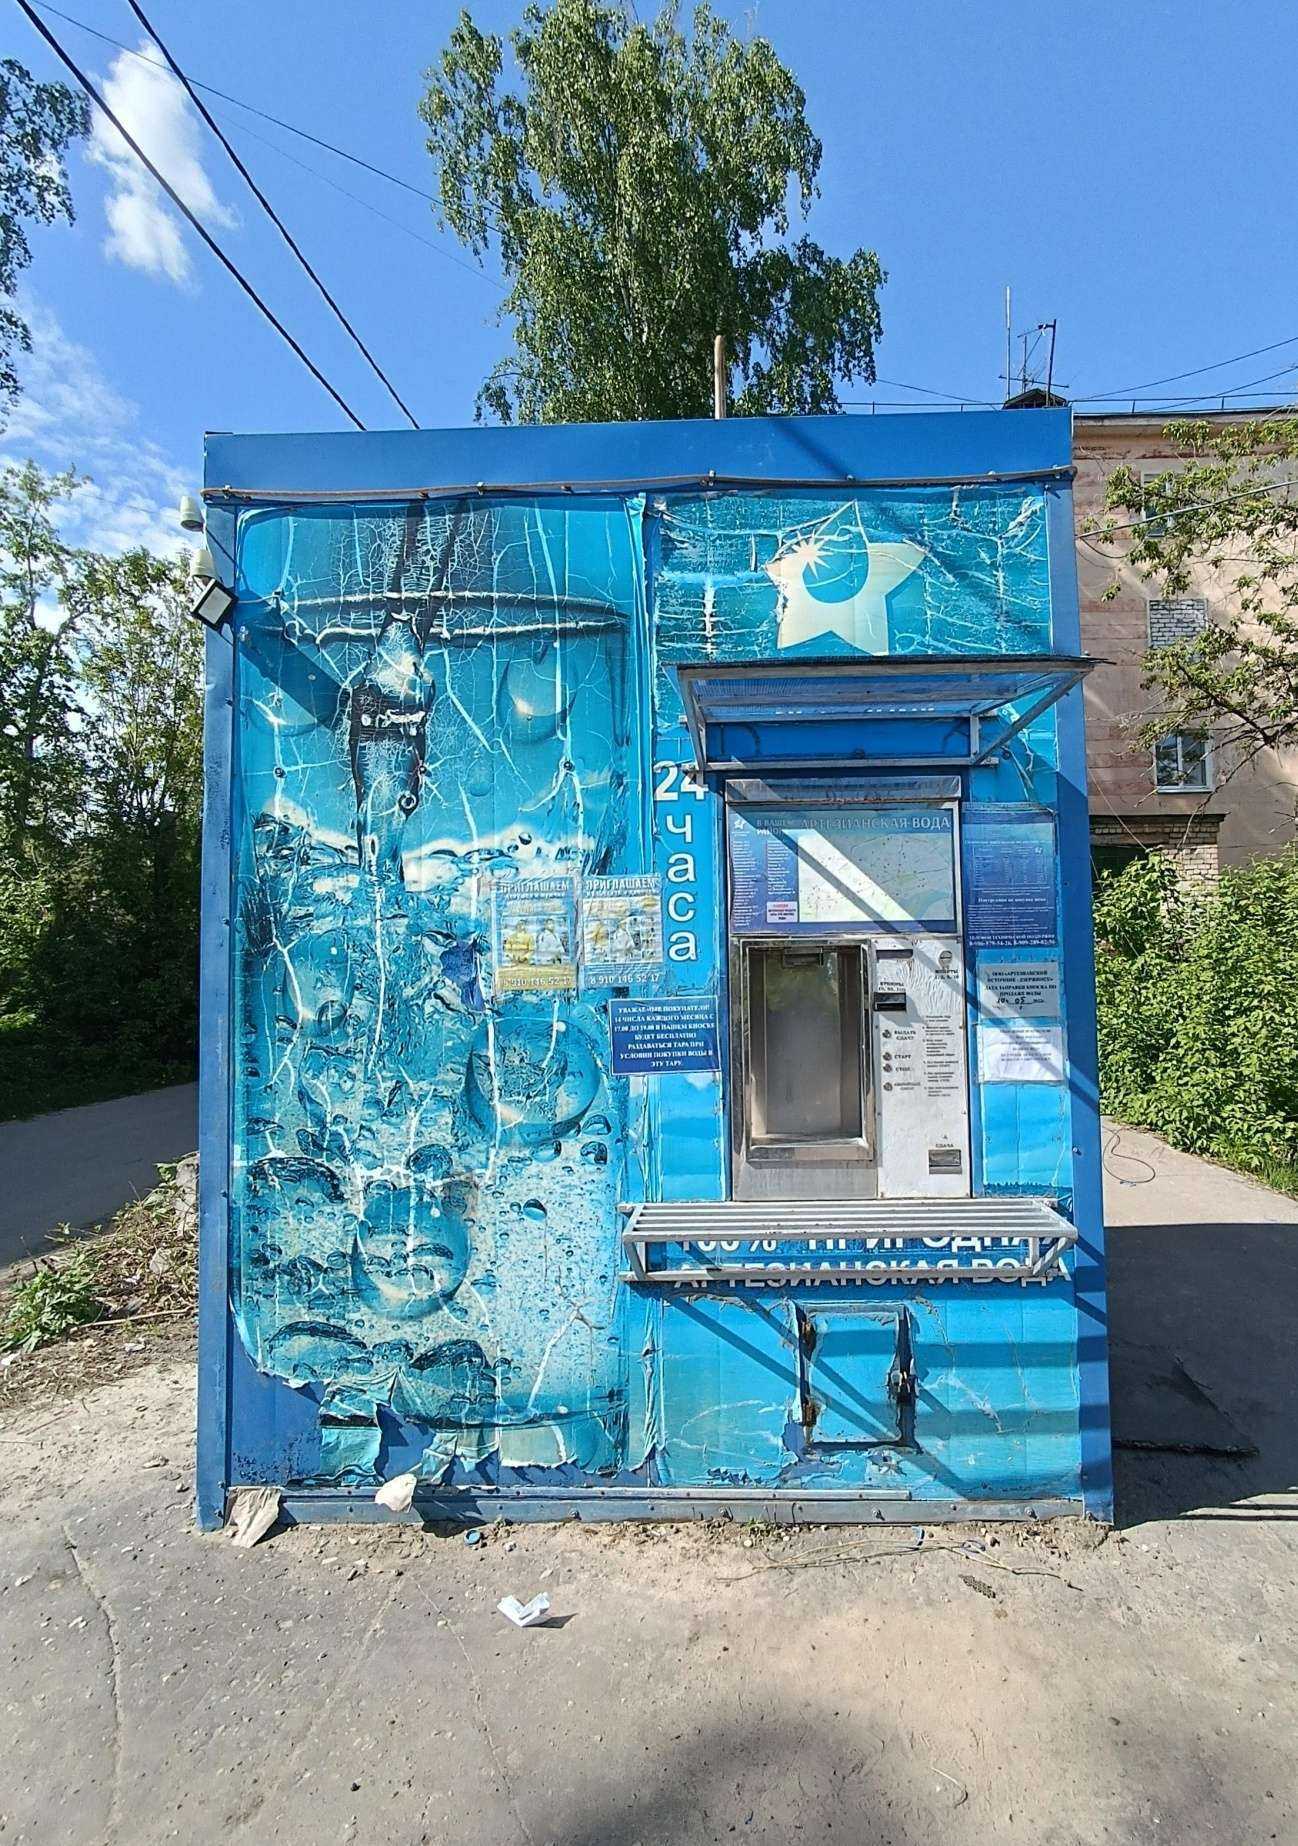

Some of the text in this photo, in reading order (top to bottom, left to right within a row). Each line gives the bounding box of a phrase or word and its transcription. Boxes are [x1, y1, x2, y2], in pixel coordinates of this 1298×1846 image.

[653, 760, 709, 801] 24
[912, 816, 950, 831] ВОДА
[585, 877, 656, 891] ПРИГЛАШАЕМ
[549, 976, 560, 985] 52
[599, 975, 614, 984] 910
[618, 974, 633, 984] 146
[636, 974, 647, 983] 52
[651, 973, 660, 982] 17
[656, 1032, 697, 1040] БЕСПЛАТНО
